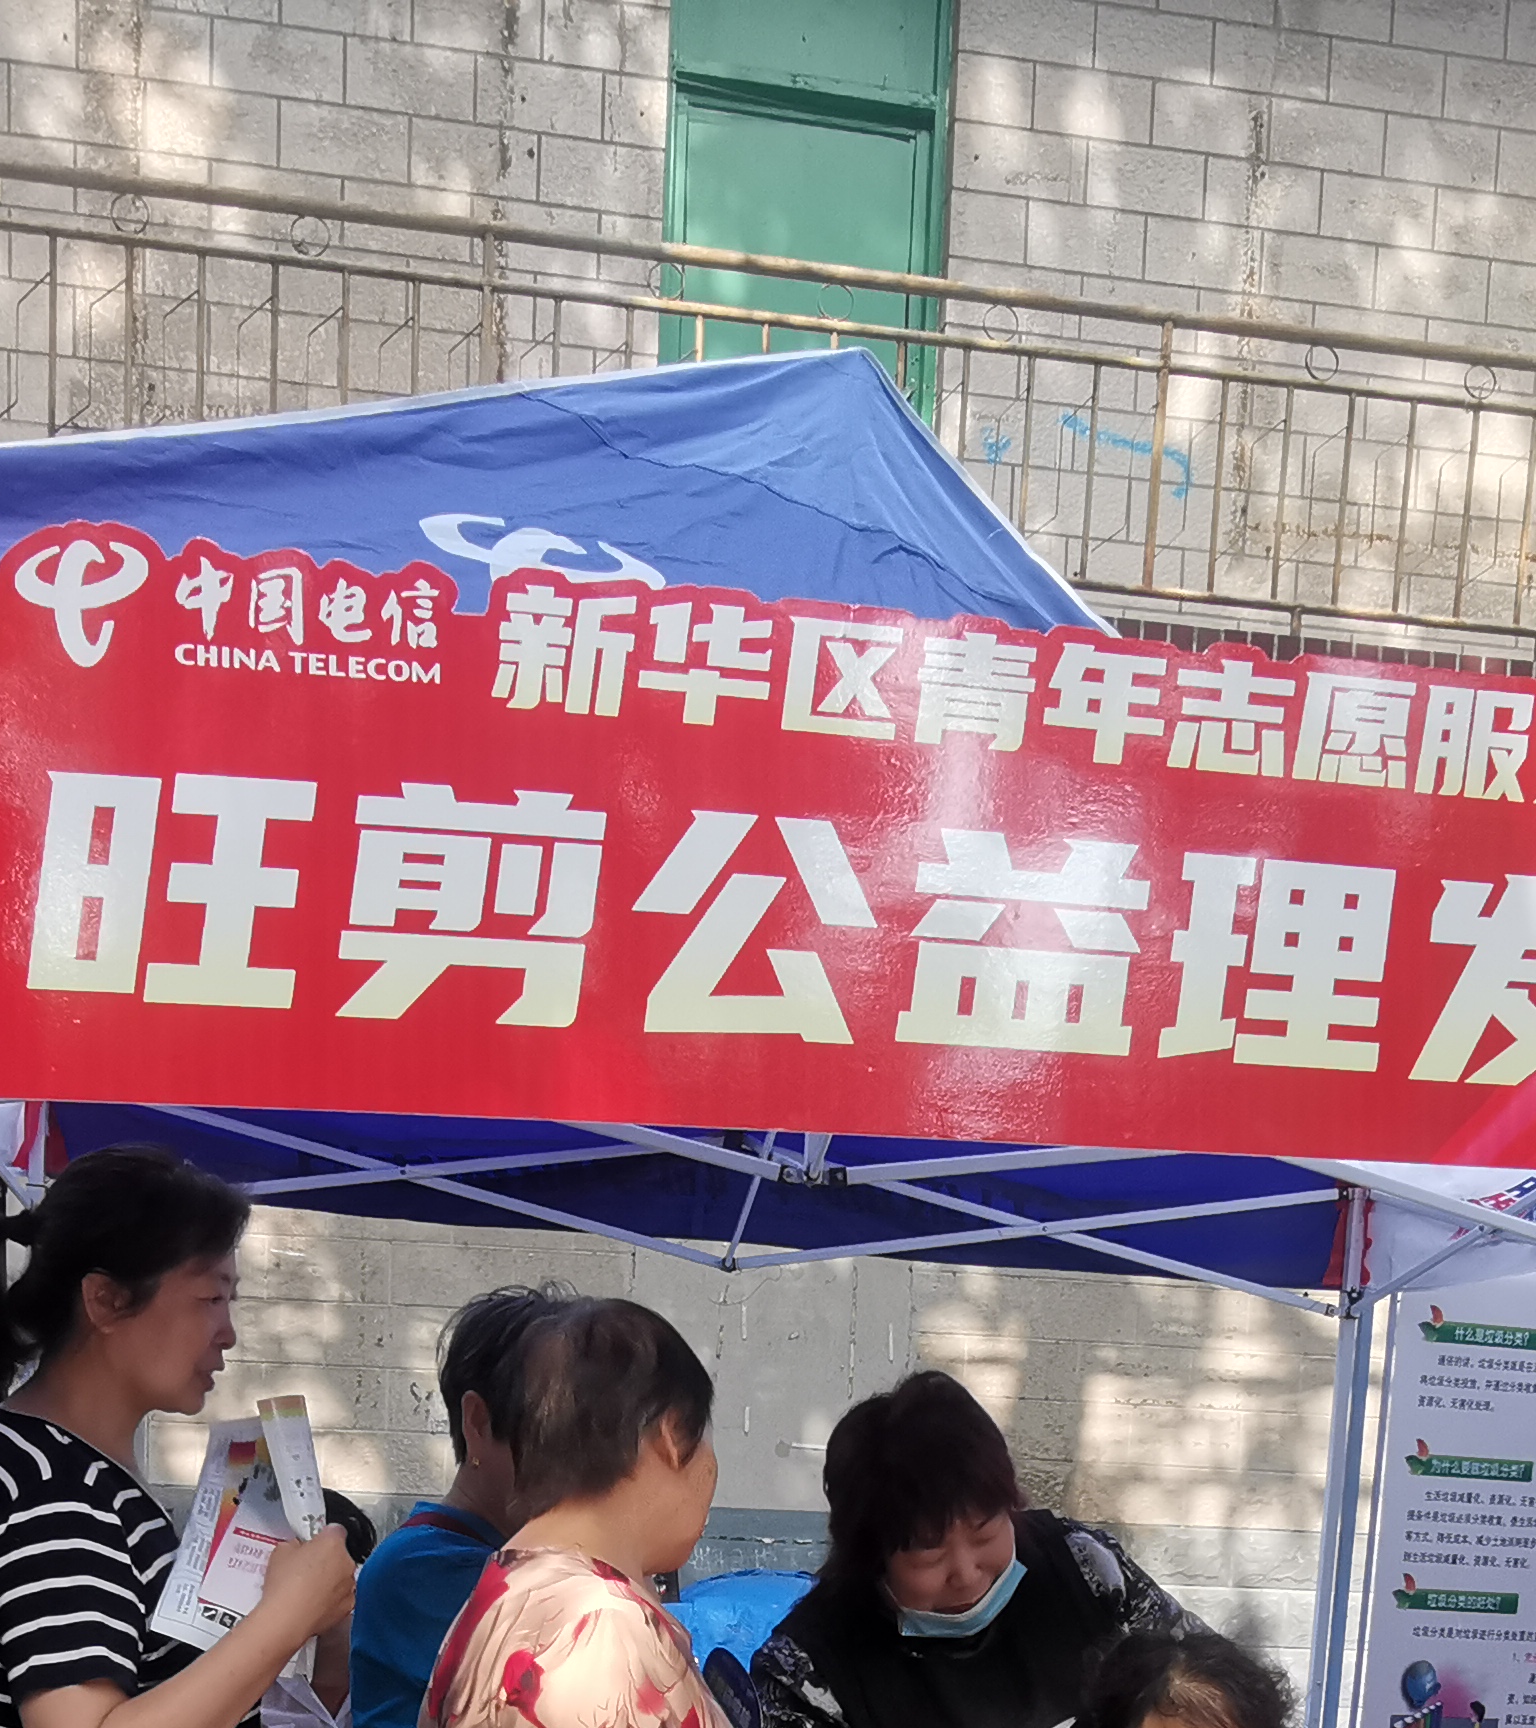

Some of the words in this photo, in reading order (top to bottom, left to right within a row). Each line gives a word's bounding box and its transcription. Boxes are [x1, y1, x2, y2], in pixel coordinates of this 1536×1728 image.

[174, 556, 441, 649] 中国电信
[174, 643, 281, 673] CHINA
[287, 651, 442, 685] TELECOM
